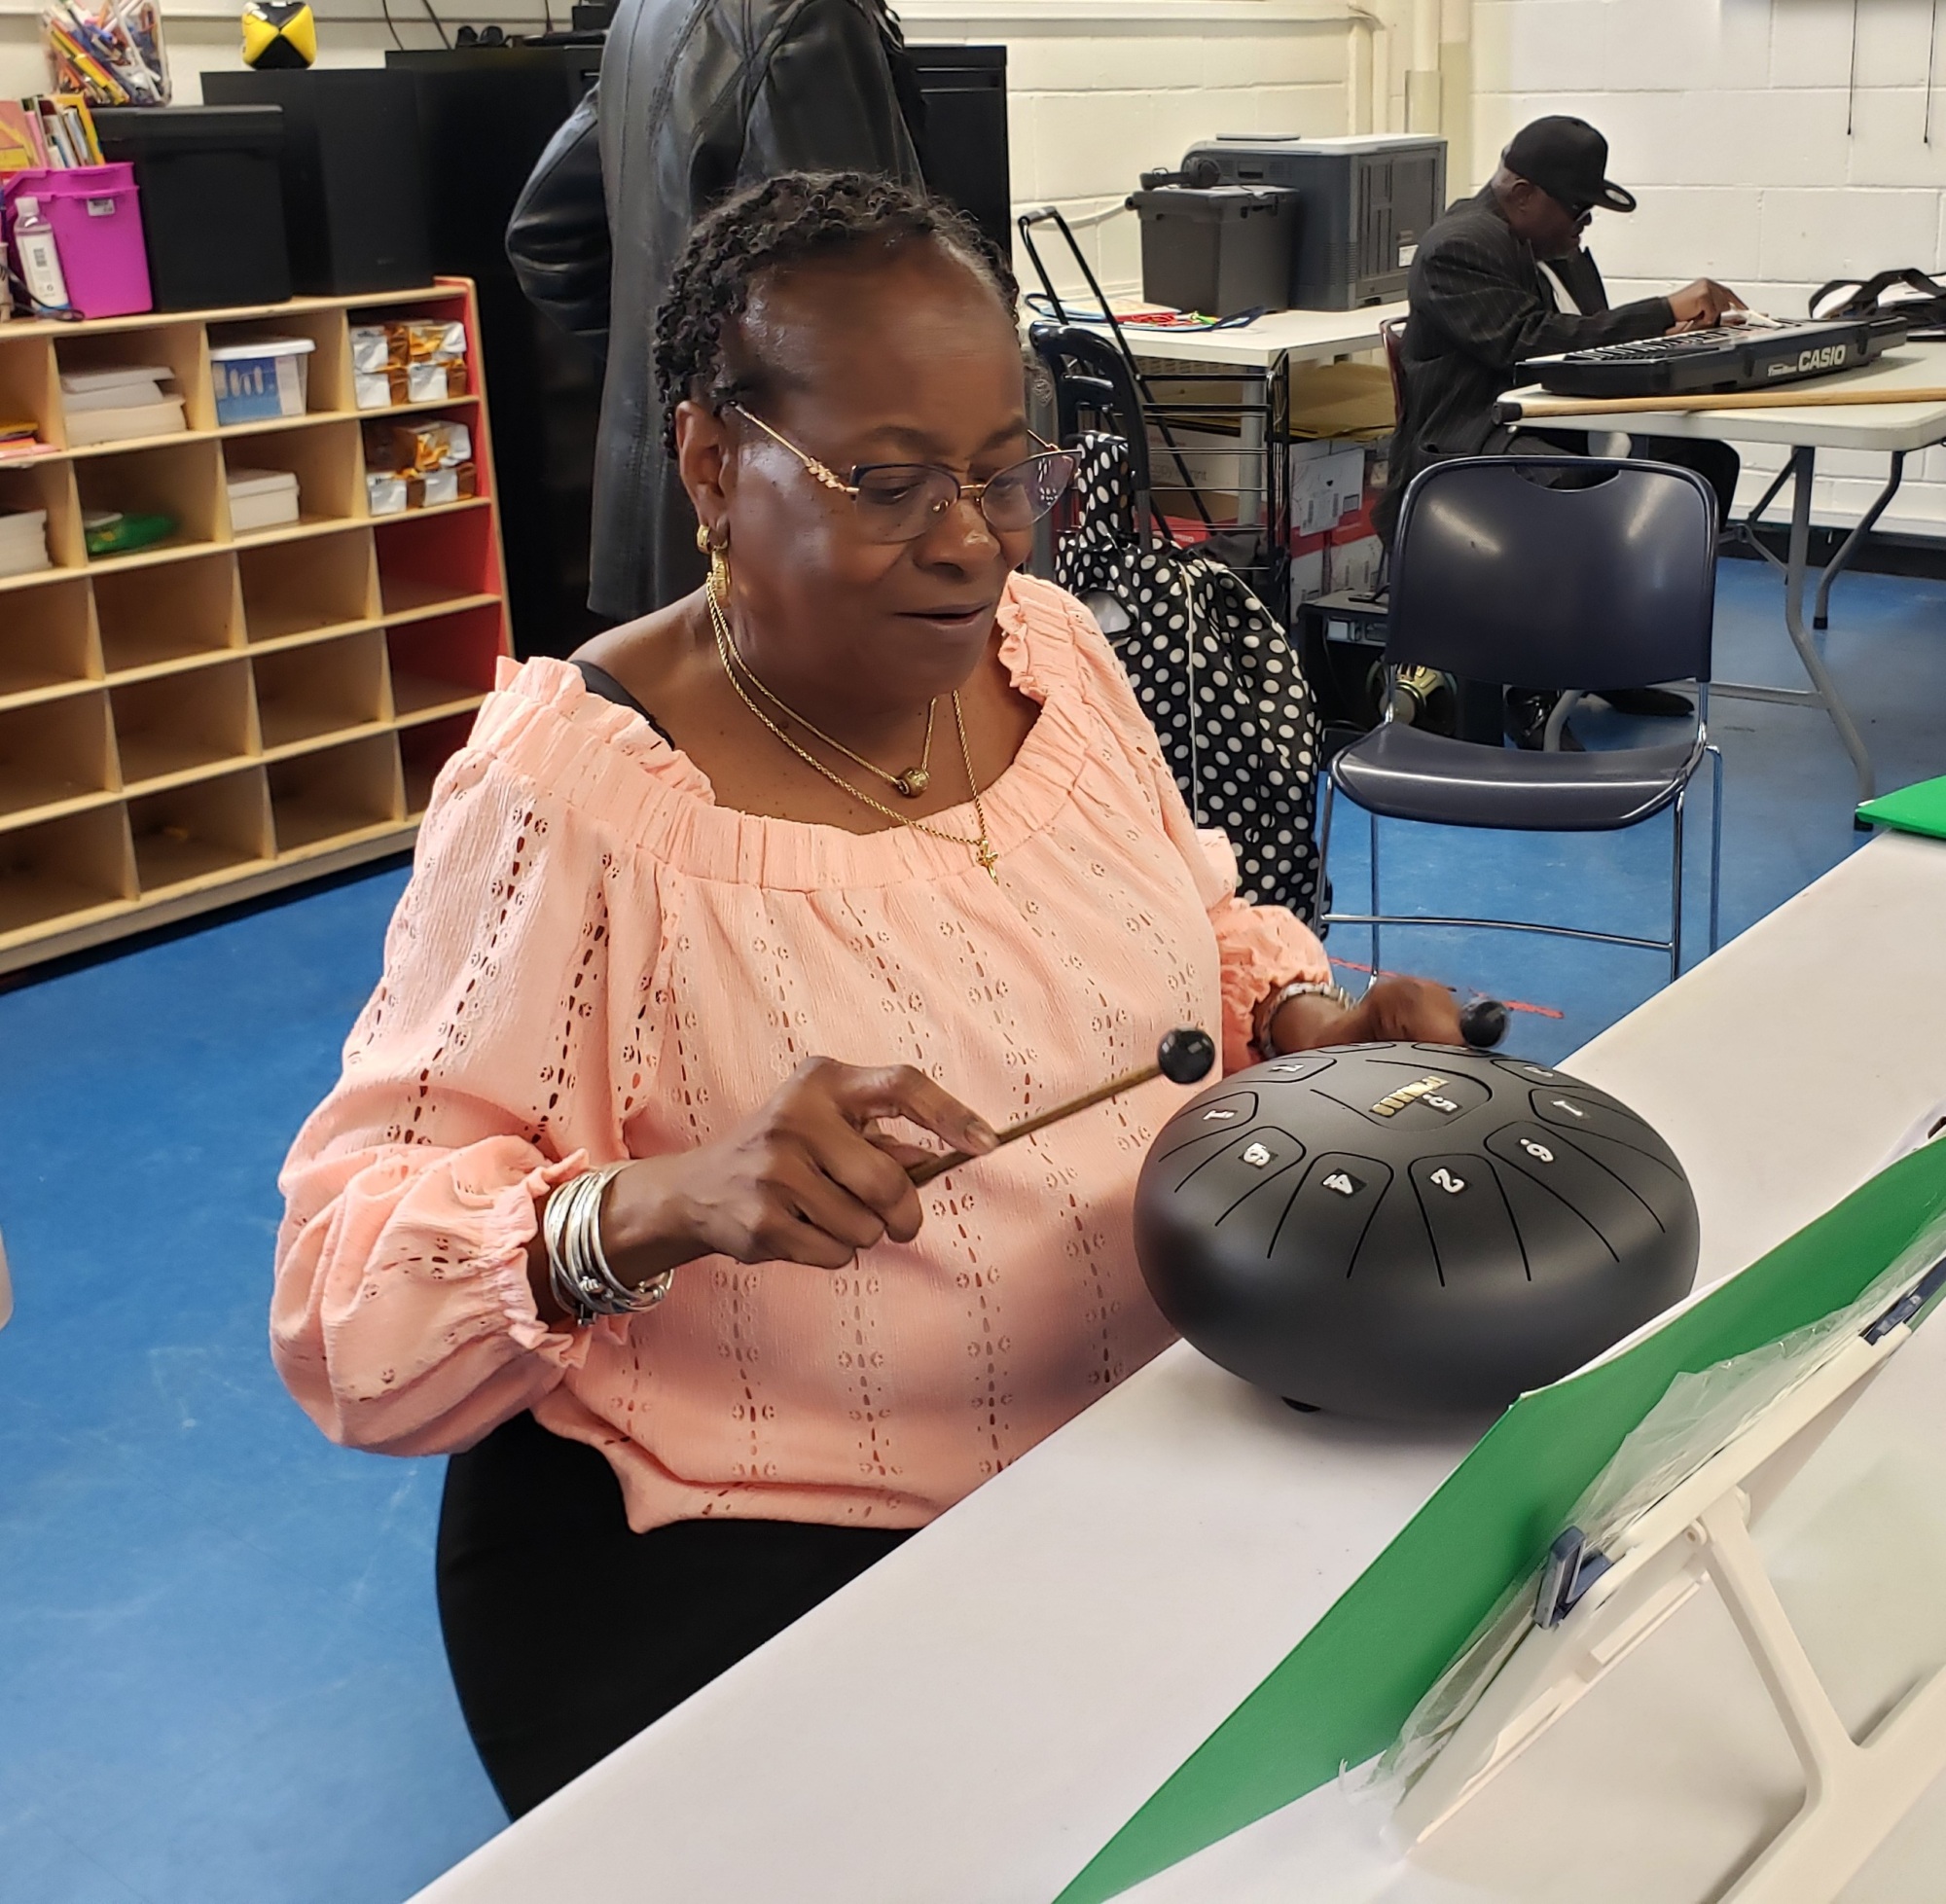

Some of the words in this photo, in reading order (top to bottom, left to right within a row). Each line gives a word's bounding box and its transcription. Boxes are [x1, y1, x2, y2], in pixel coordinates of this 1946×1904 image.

[1798, 344, 1846, 372] CASIO
[1323, 1173, 1353, 1195] 4
[1430, 1168, 1464, 1193] 2
